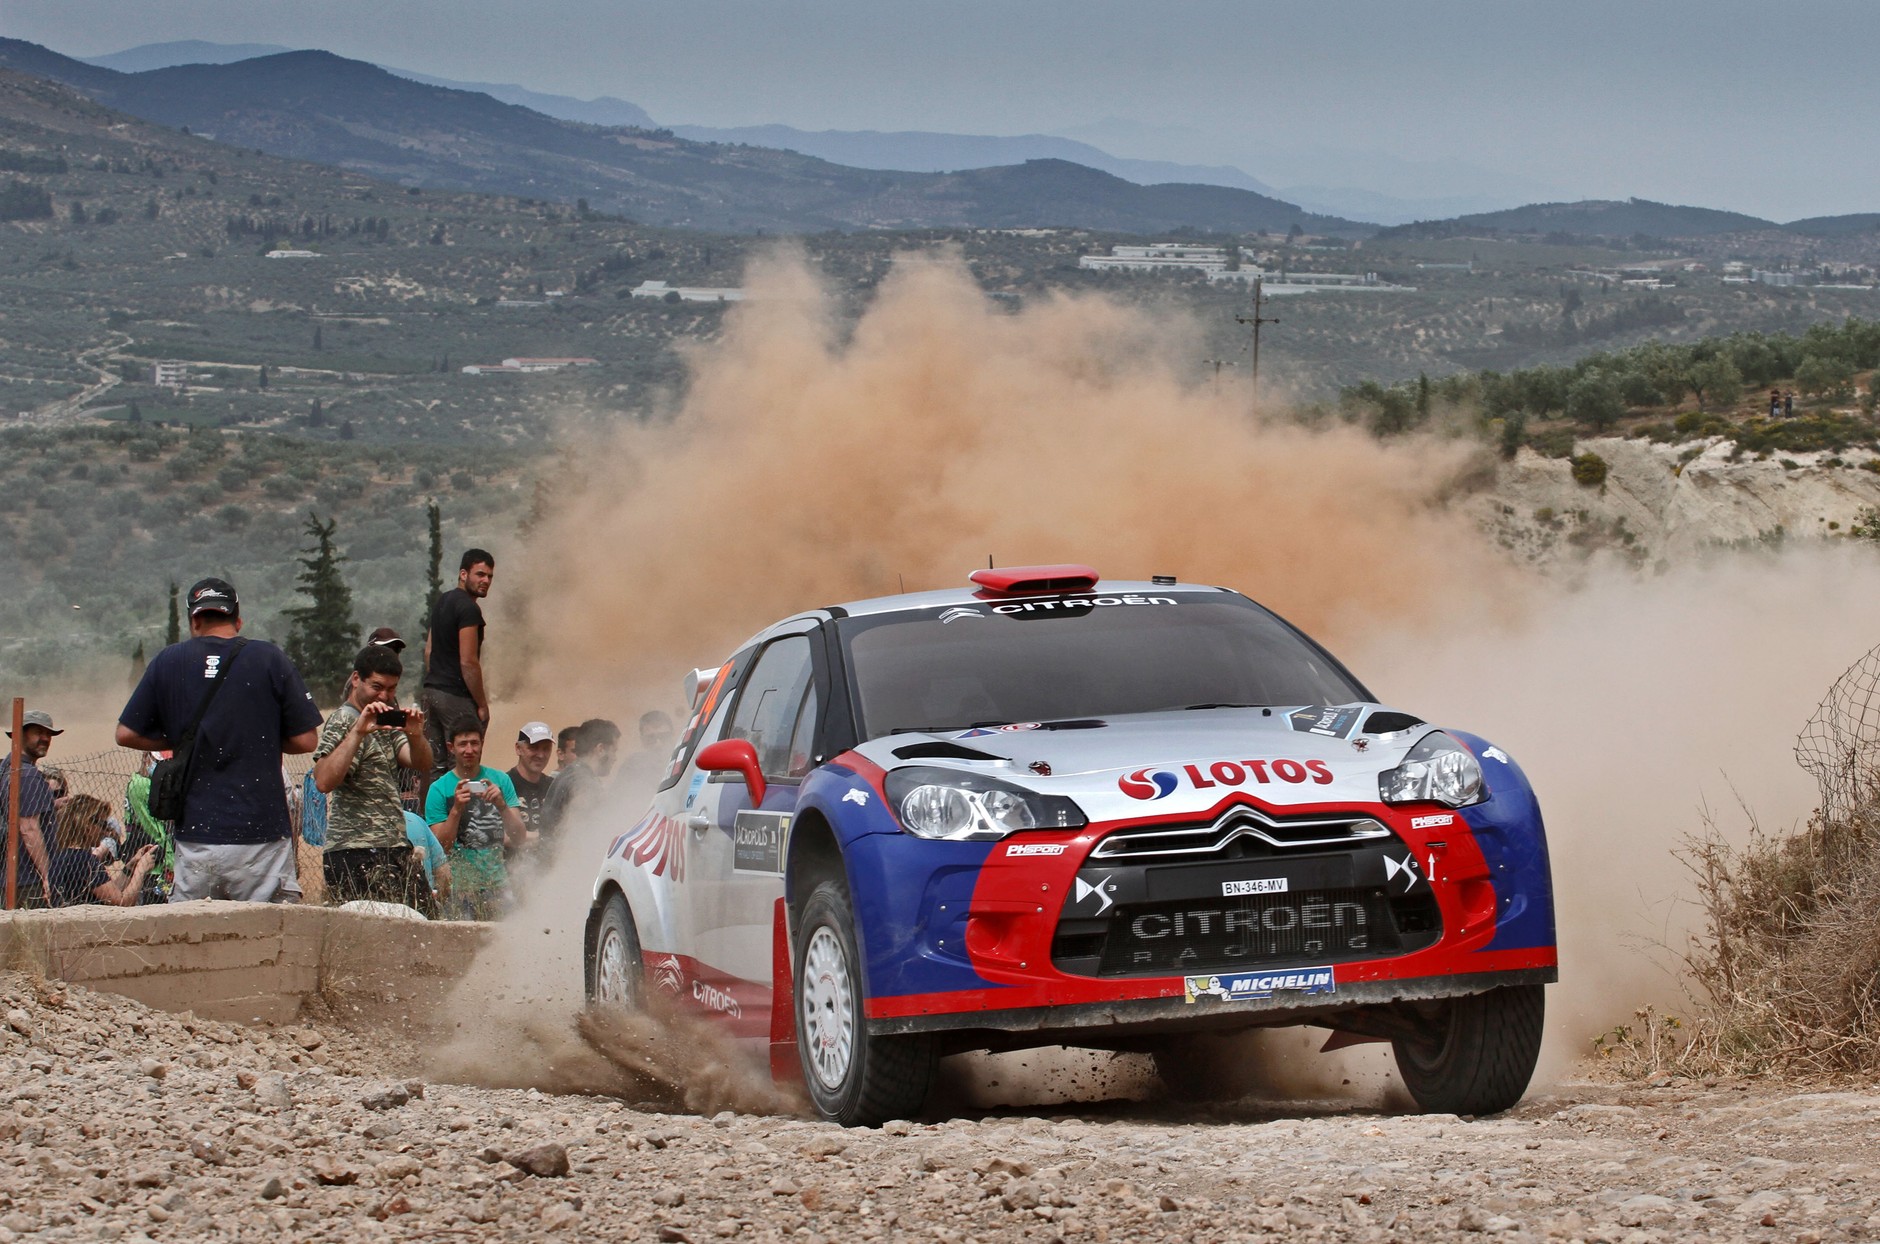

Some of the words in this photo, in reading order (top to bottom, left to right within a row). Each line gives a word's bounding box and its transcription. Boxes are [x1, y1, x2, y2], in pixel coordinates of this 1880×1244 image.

[1184, 758, 1334, 789] LOTOS
[622, 812, 687, 884] LOTOS
[1225, 880, 1284, 894] BN-346-MV
[1133, 935, 1367, 962] RACING
[1231, 973, 1331, 991] MICHELIN
